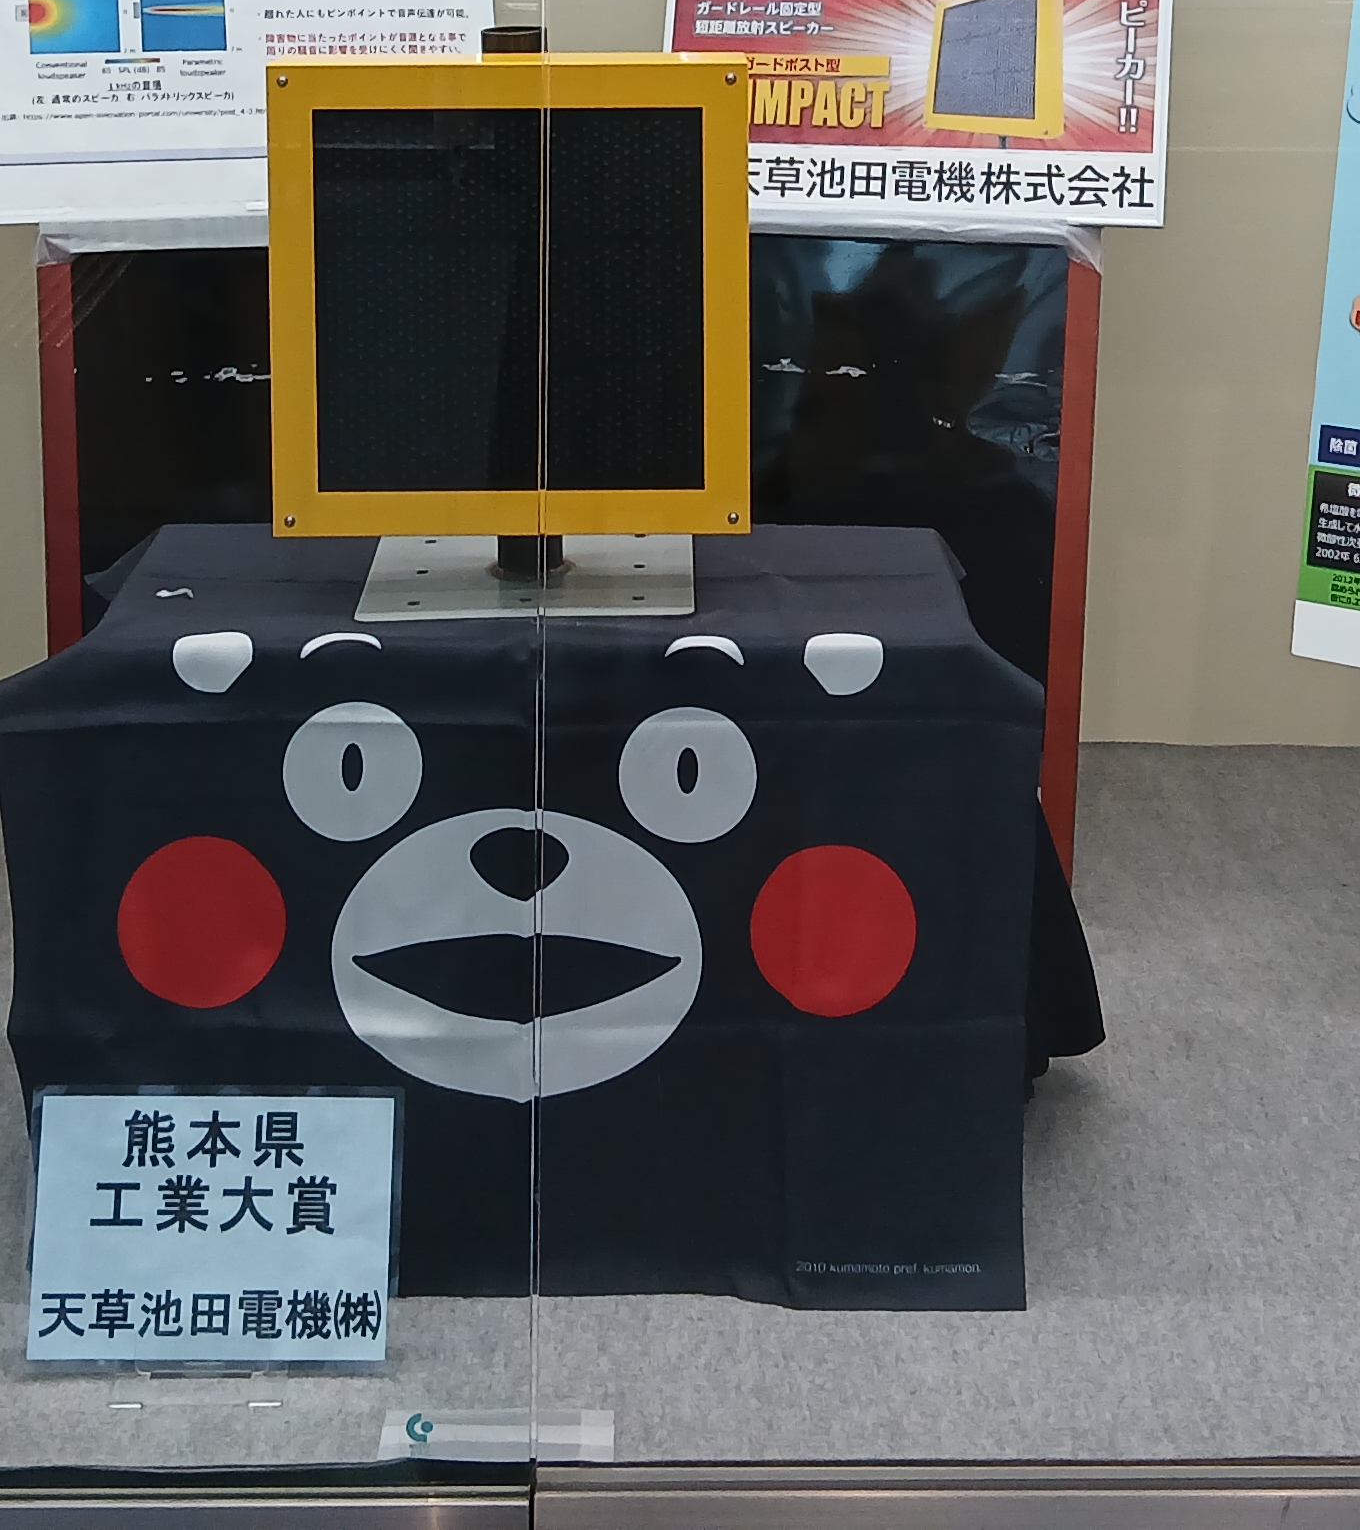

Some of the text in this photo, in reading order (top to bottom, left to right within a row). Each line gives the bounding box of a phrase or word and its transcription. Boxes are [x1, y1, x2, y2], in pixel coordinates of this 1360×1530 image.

[697, 1, 822, 17] ガードレール固定型
[1329, 437, 1357, 455] 除菌
[122, 1109, 305, 1168] 熊本県
[89, 1174, 337, 1235] 工業大賞
